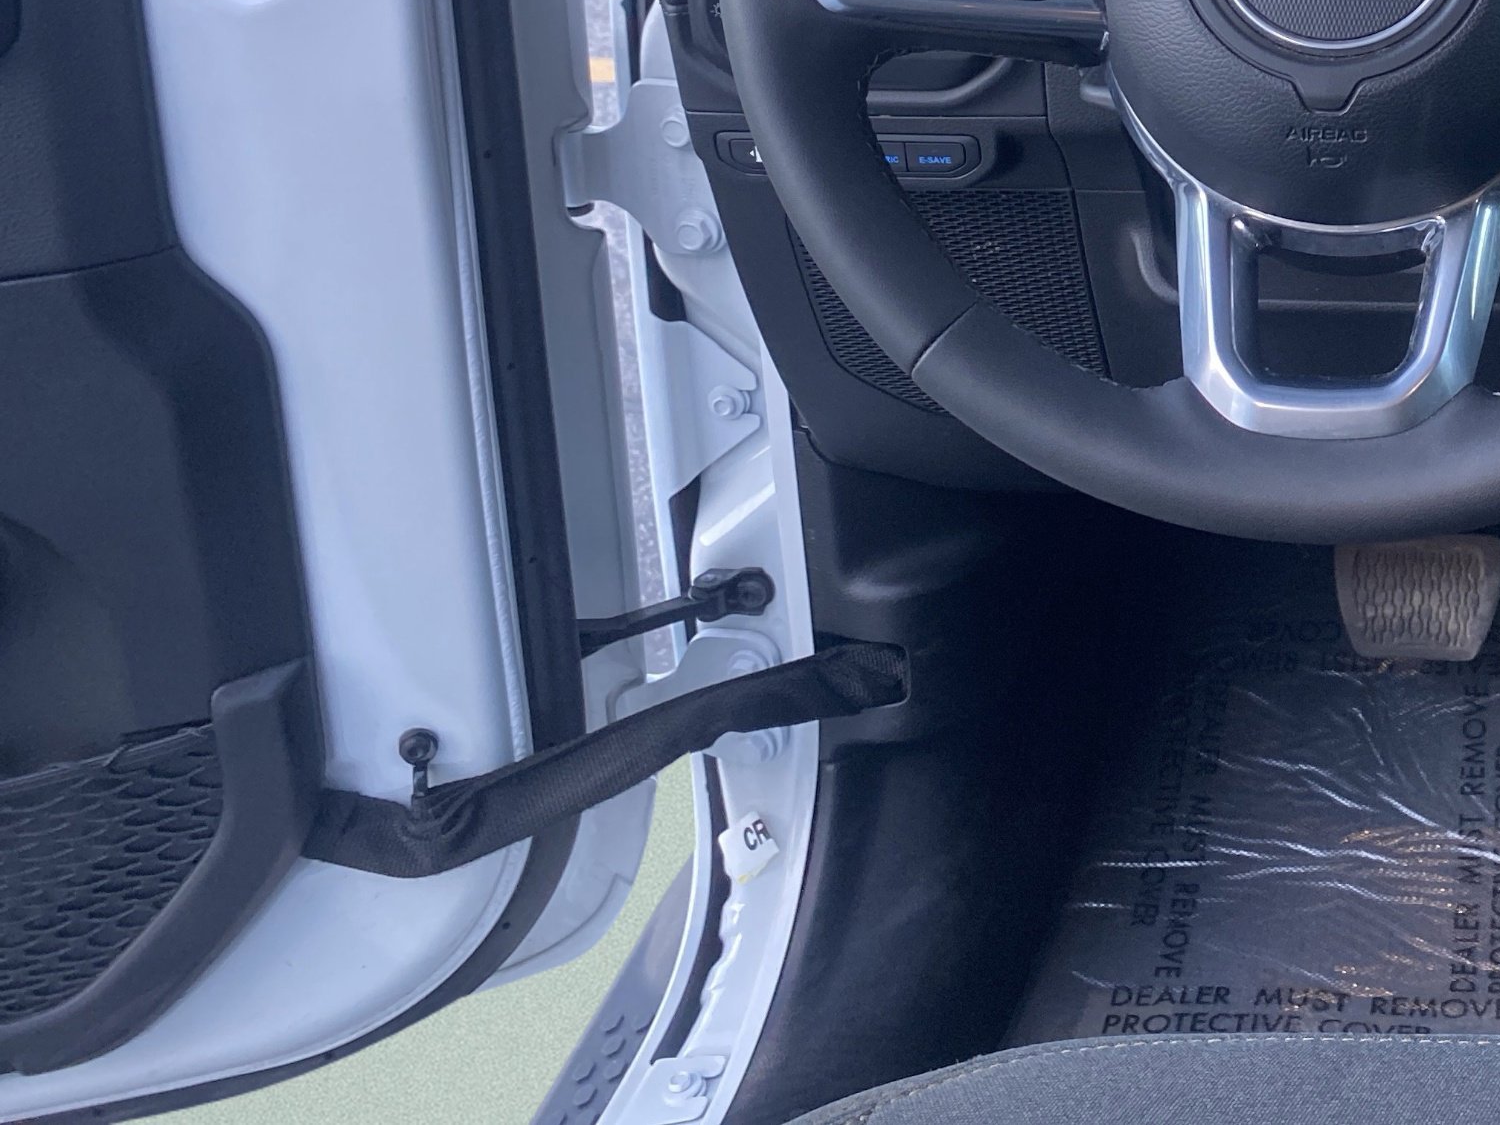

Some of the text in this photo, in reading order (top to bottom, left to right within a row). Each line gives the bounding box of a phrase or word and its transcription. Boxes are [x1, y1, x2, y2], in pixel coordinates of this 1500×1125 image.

[1286, 128, 1368, 144] AIRBAG
[918, 156, 952, 165] E-SAVE
[1458, 682, 1491, 799] REMOVE
[1153, 880, 1201, 980] REMOVE
[1446, 902, 1481, 996] DEALER
[1110, 985, 1232, 1008] DEALER
[1253, 985, 1351, 1015] MUST
[1100, 1012, 1302, 1036] PROTECTIVE
